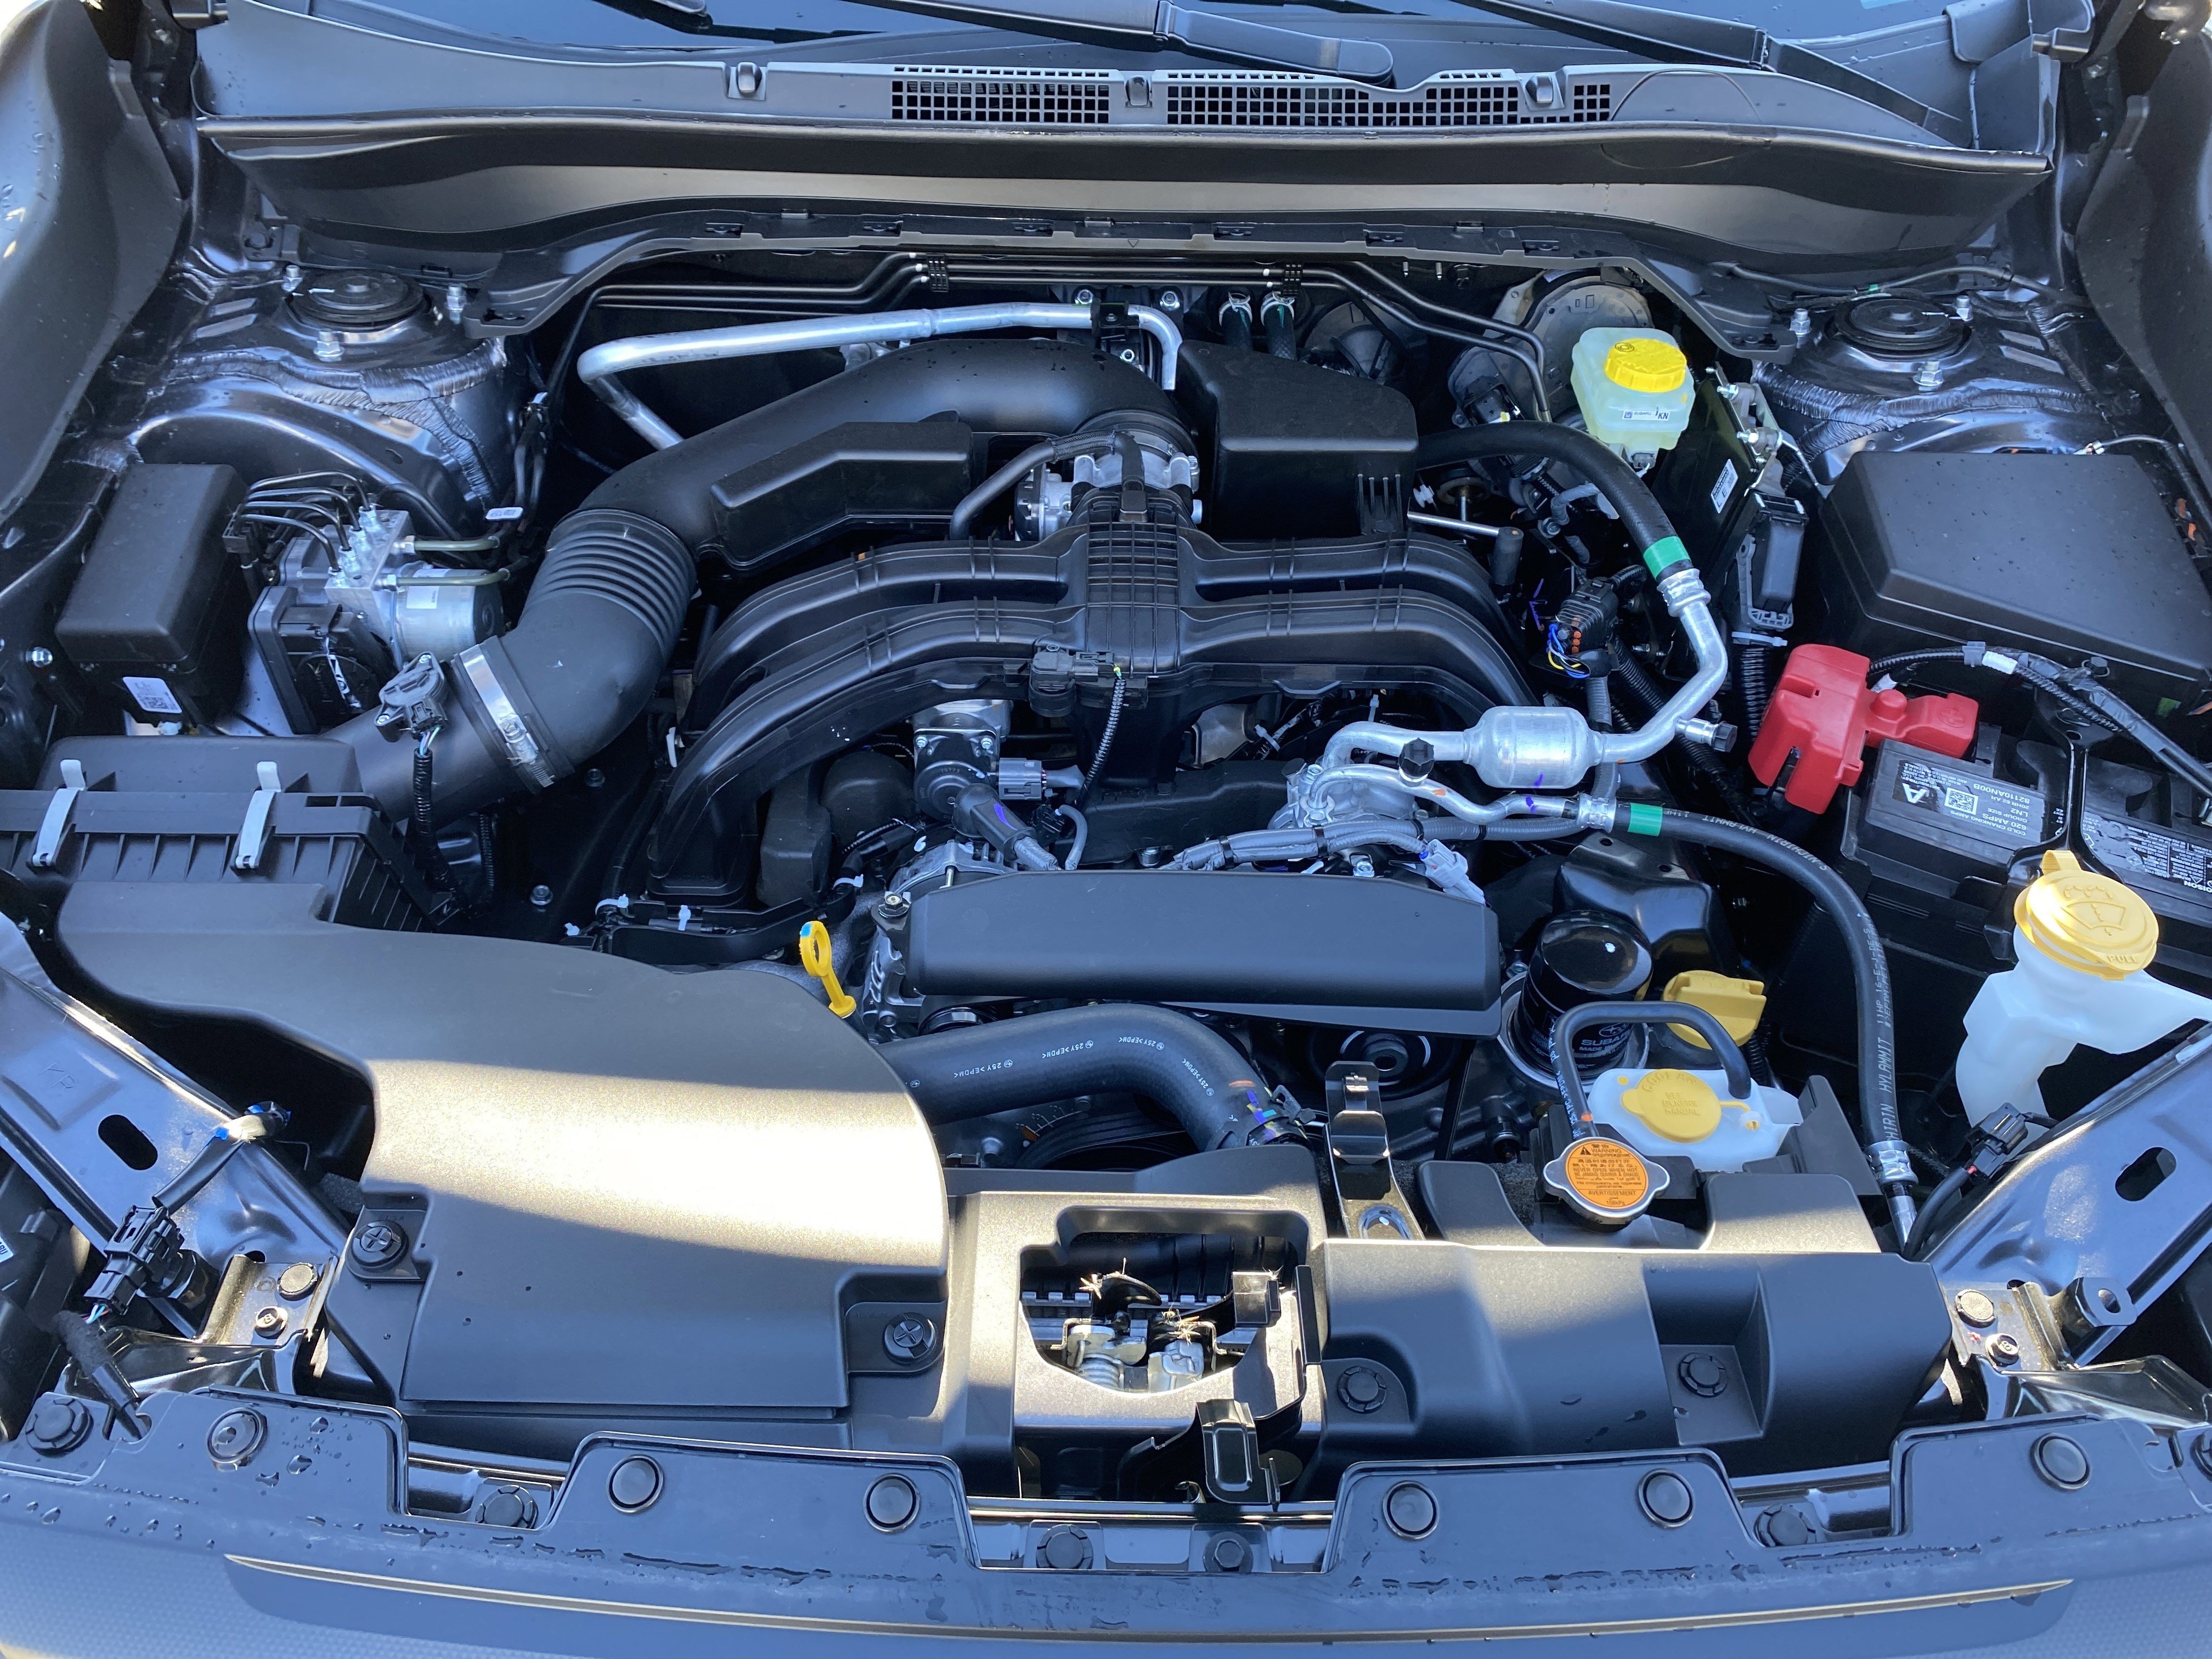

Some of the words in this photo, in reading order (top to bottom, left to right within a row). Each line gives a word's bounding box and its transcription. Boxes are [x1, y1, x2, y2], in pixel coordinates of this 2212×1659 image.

[1973, 783, 2030, 804] 82110AN00B
[2011, 802, 2029, 810] 20HR
[1950, 810, 1970, 819] AMPS
[2010, 808, 2028, 817] LN2
[1971, 816, 2006, 830] CRANKING
[1982, 813, 2009, 825] AMPS
[2004, 814, 2028, 823] GROUP
[2011, 821, 2027, 831] 620
[2007, 827, 2025, 836] COLD
[2106, 954, 2140, 964] PULL
[1144, 1037, 1156, 1047] 25Y
[1581, 1031, 1631, 1046] SUBAR
[1070, 1042, 1084, 1052] 25Y
[988, 1062, 1001, 1071] 25Y
[1877, 1036, 1893, 1093] HYLAMMIT
[1198, 1077, 1209, 1089] 25Y
[1642, 1070, 1707, 1092] COOLANT
